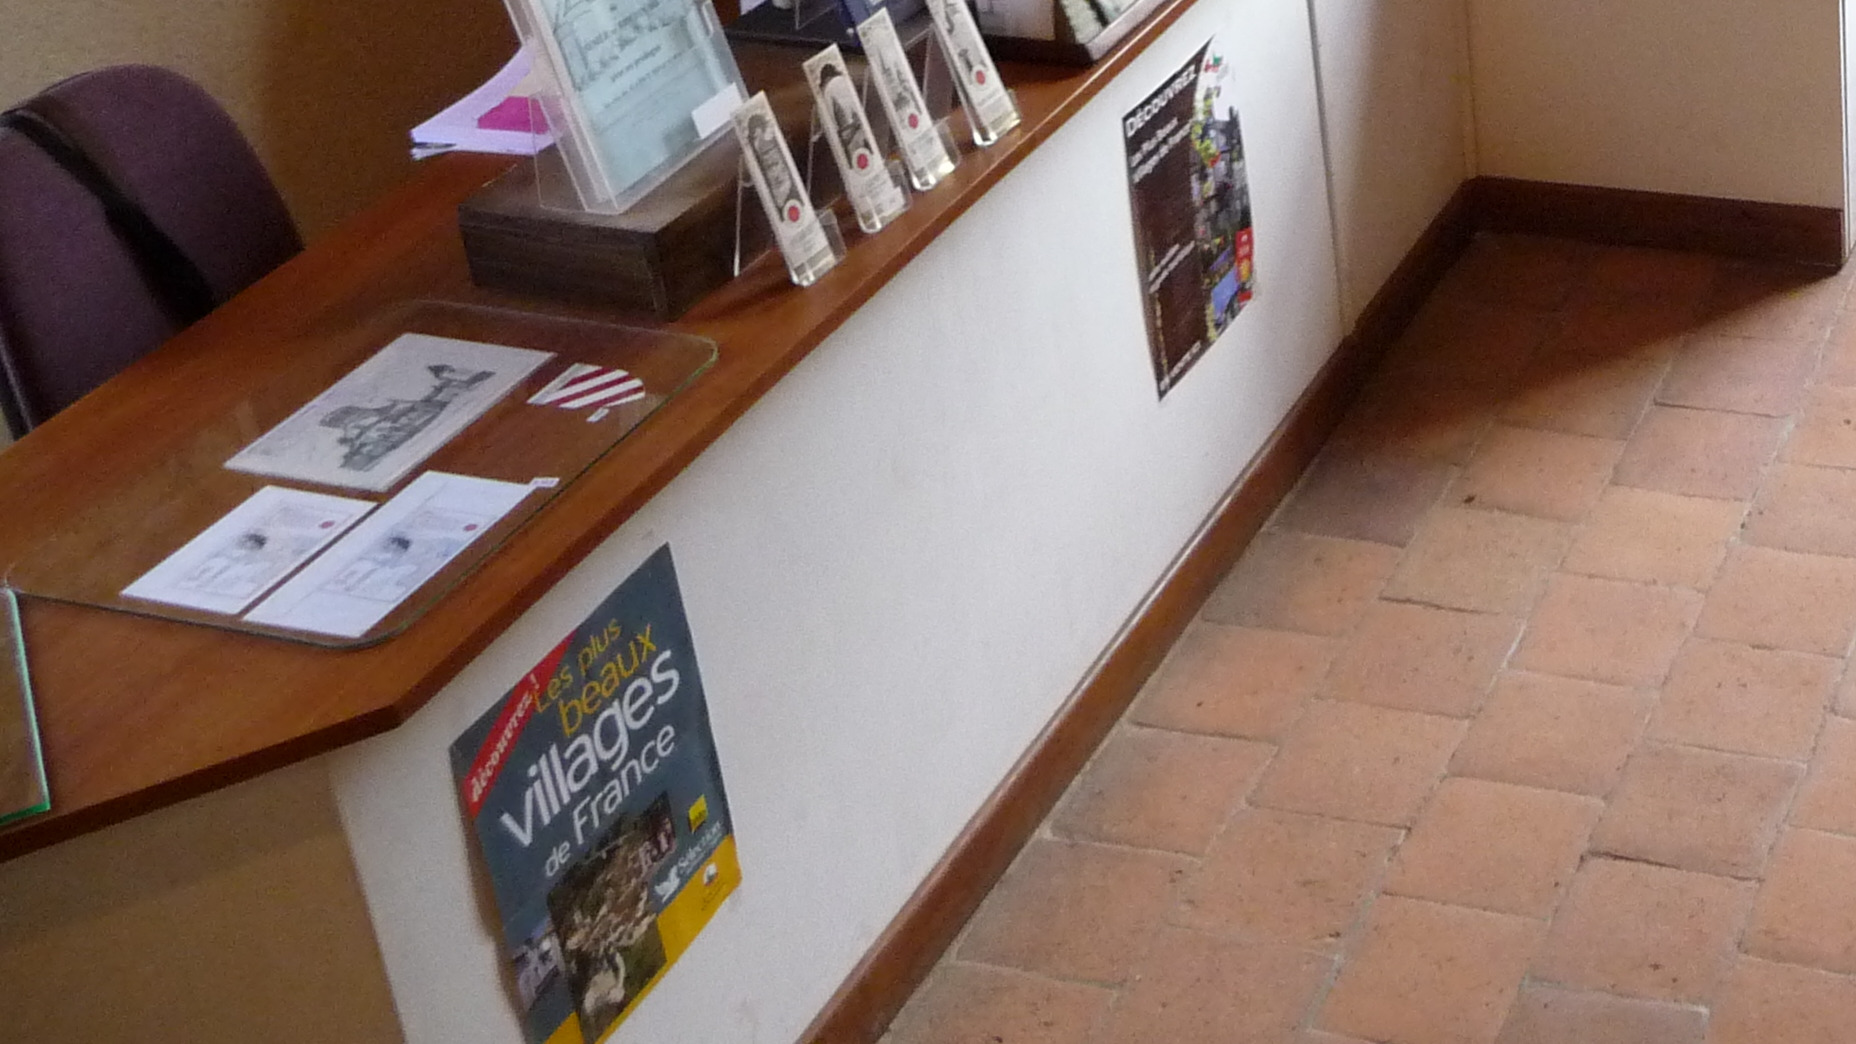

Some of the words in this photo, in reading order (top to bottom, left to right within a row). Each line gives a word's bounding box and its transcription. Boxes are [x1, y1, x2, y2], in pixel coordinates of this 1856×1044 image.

[533, 670, 574, 714] Les
[578, 617, 623, 674] plus
[558, 623, 658, 739] beaux
[471, 691, 533, 803] découvrez
[500, 648, 681, 848] villages
[545, 839, 572, 878] de
[572, 724, 676, 846] France
